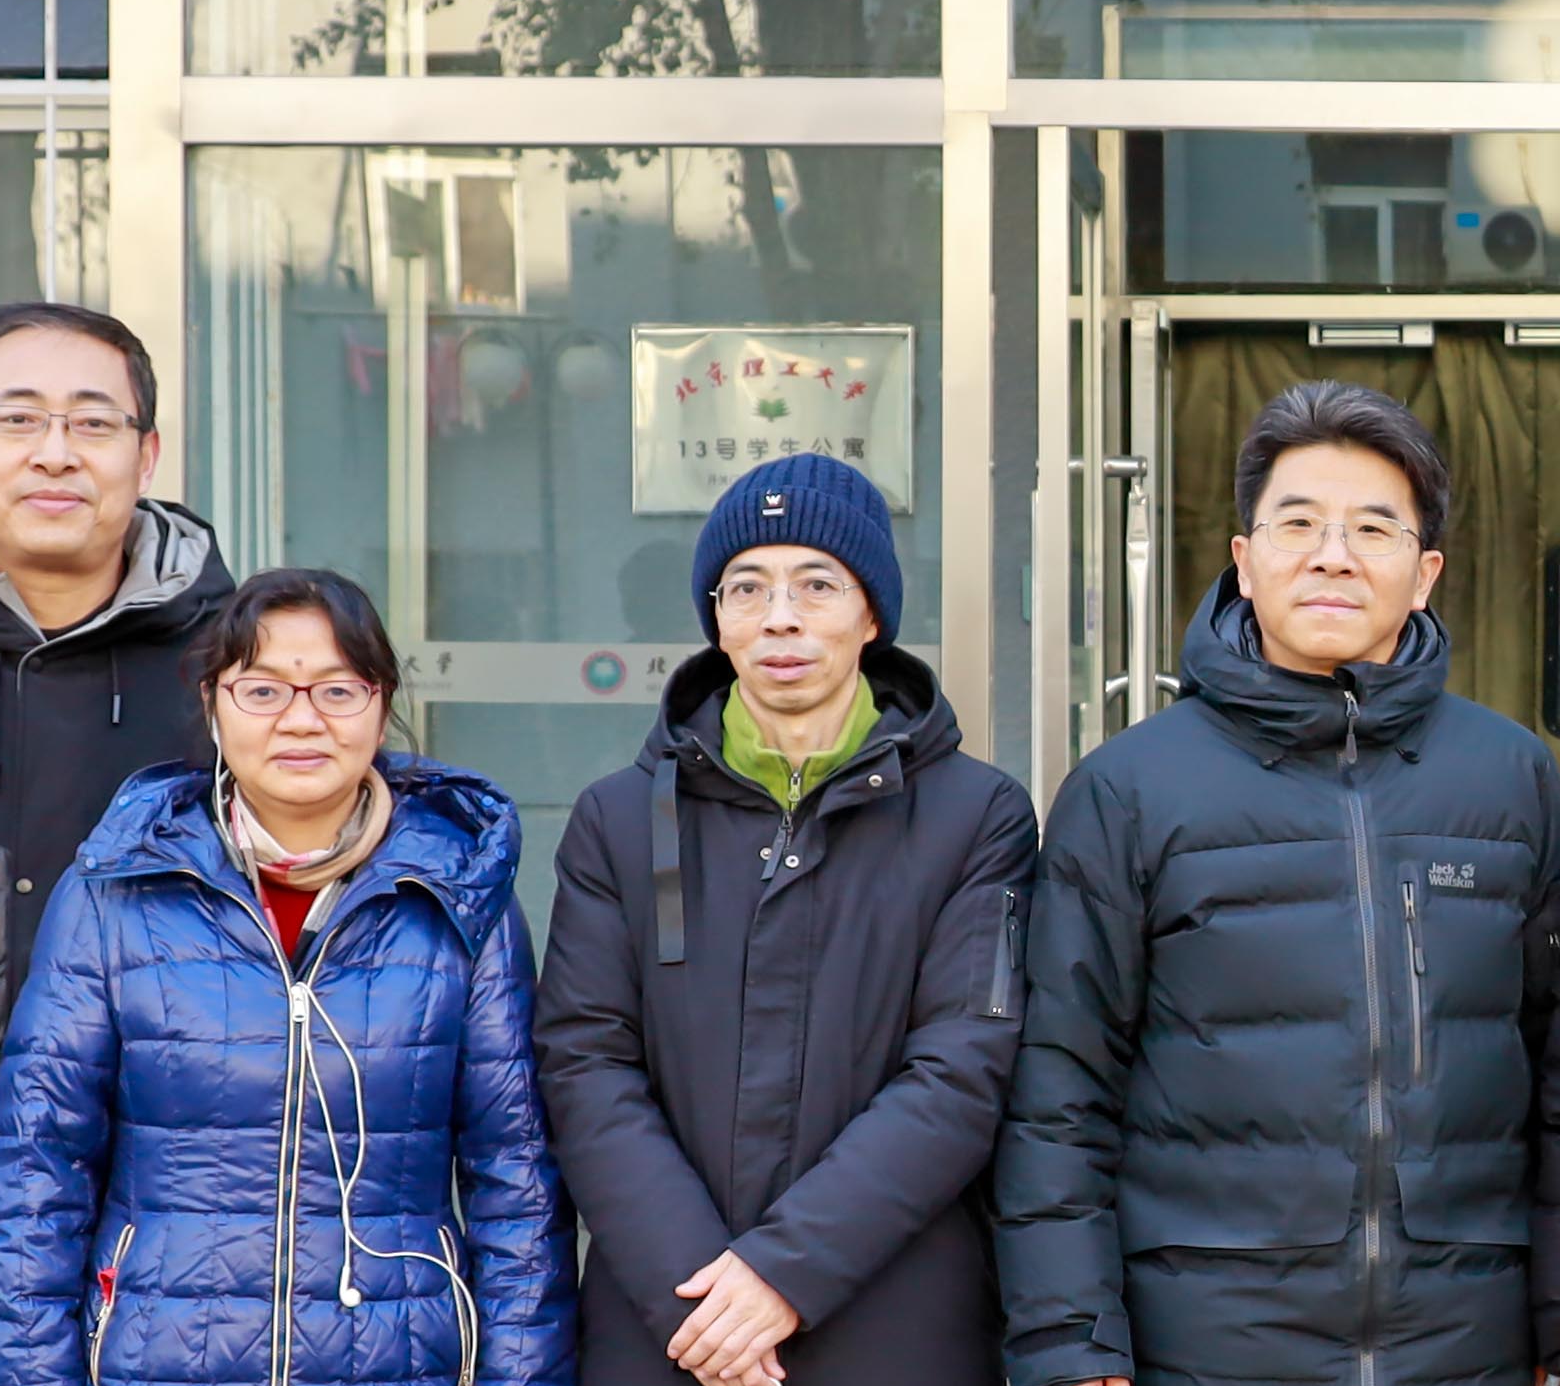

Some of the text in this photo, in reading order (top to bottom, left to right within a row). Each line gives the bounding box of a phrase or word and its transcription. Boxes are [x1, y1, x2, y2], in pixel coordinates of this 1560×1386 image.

[679, 438, 865, 459] 13号学生公寓
[1428, 862, 1455, 876] Jack
[1429, 873, 1474, 889] Wolfskin
